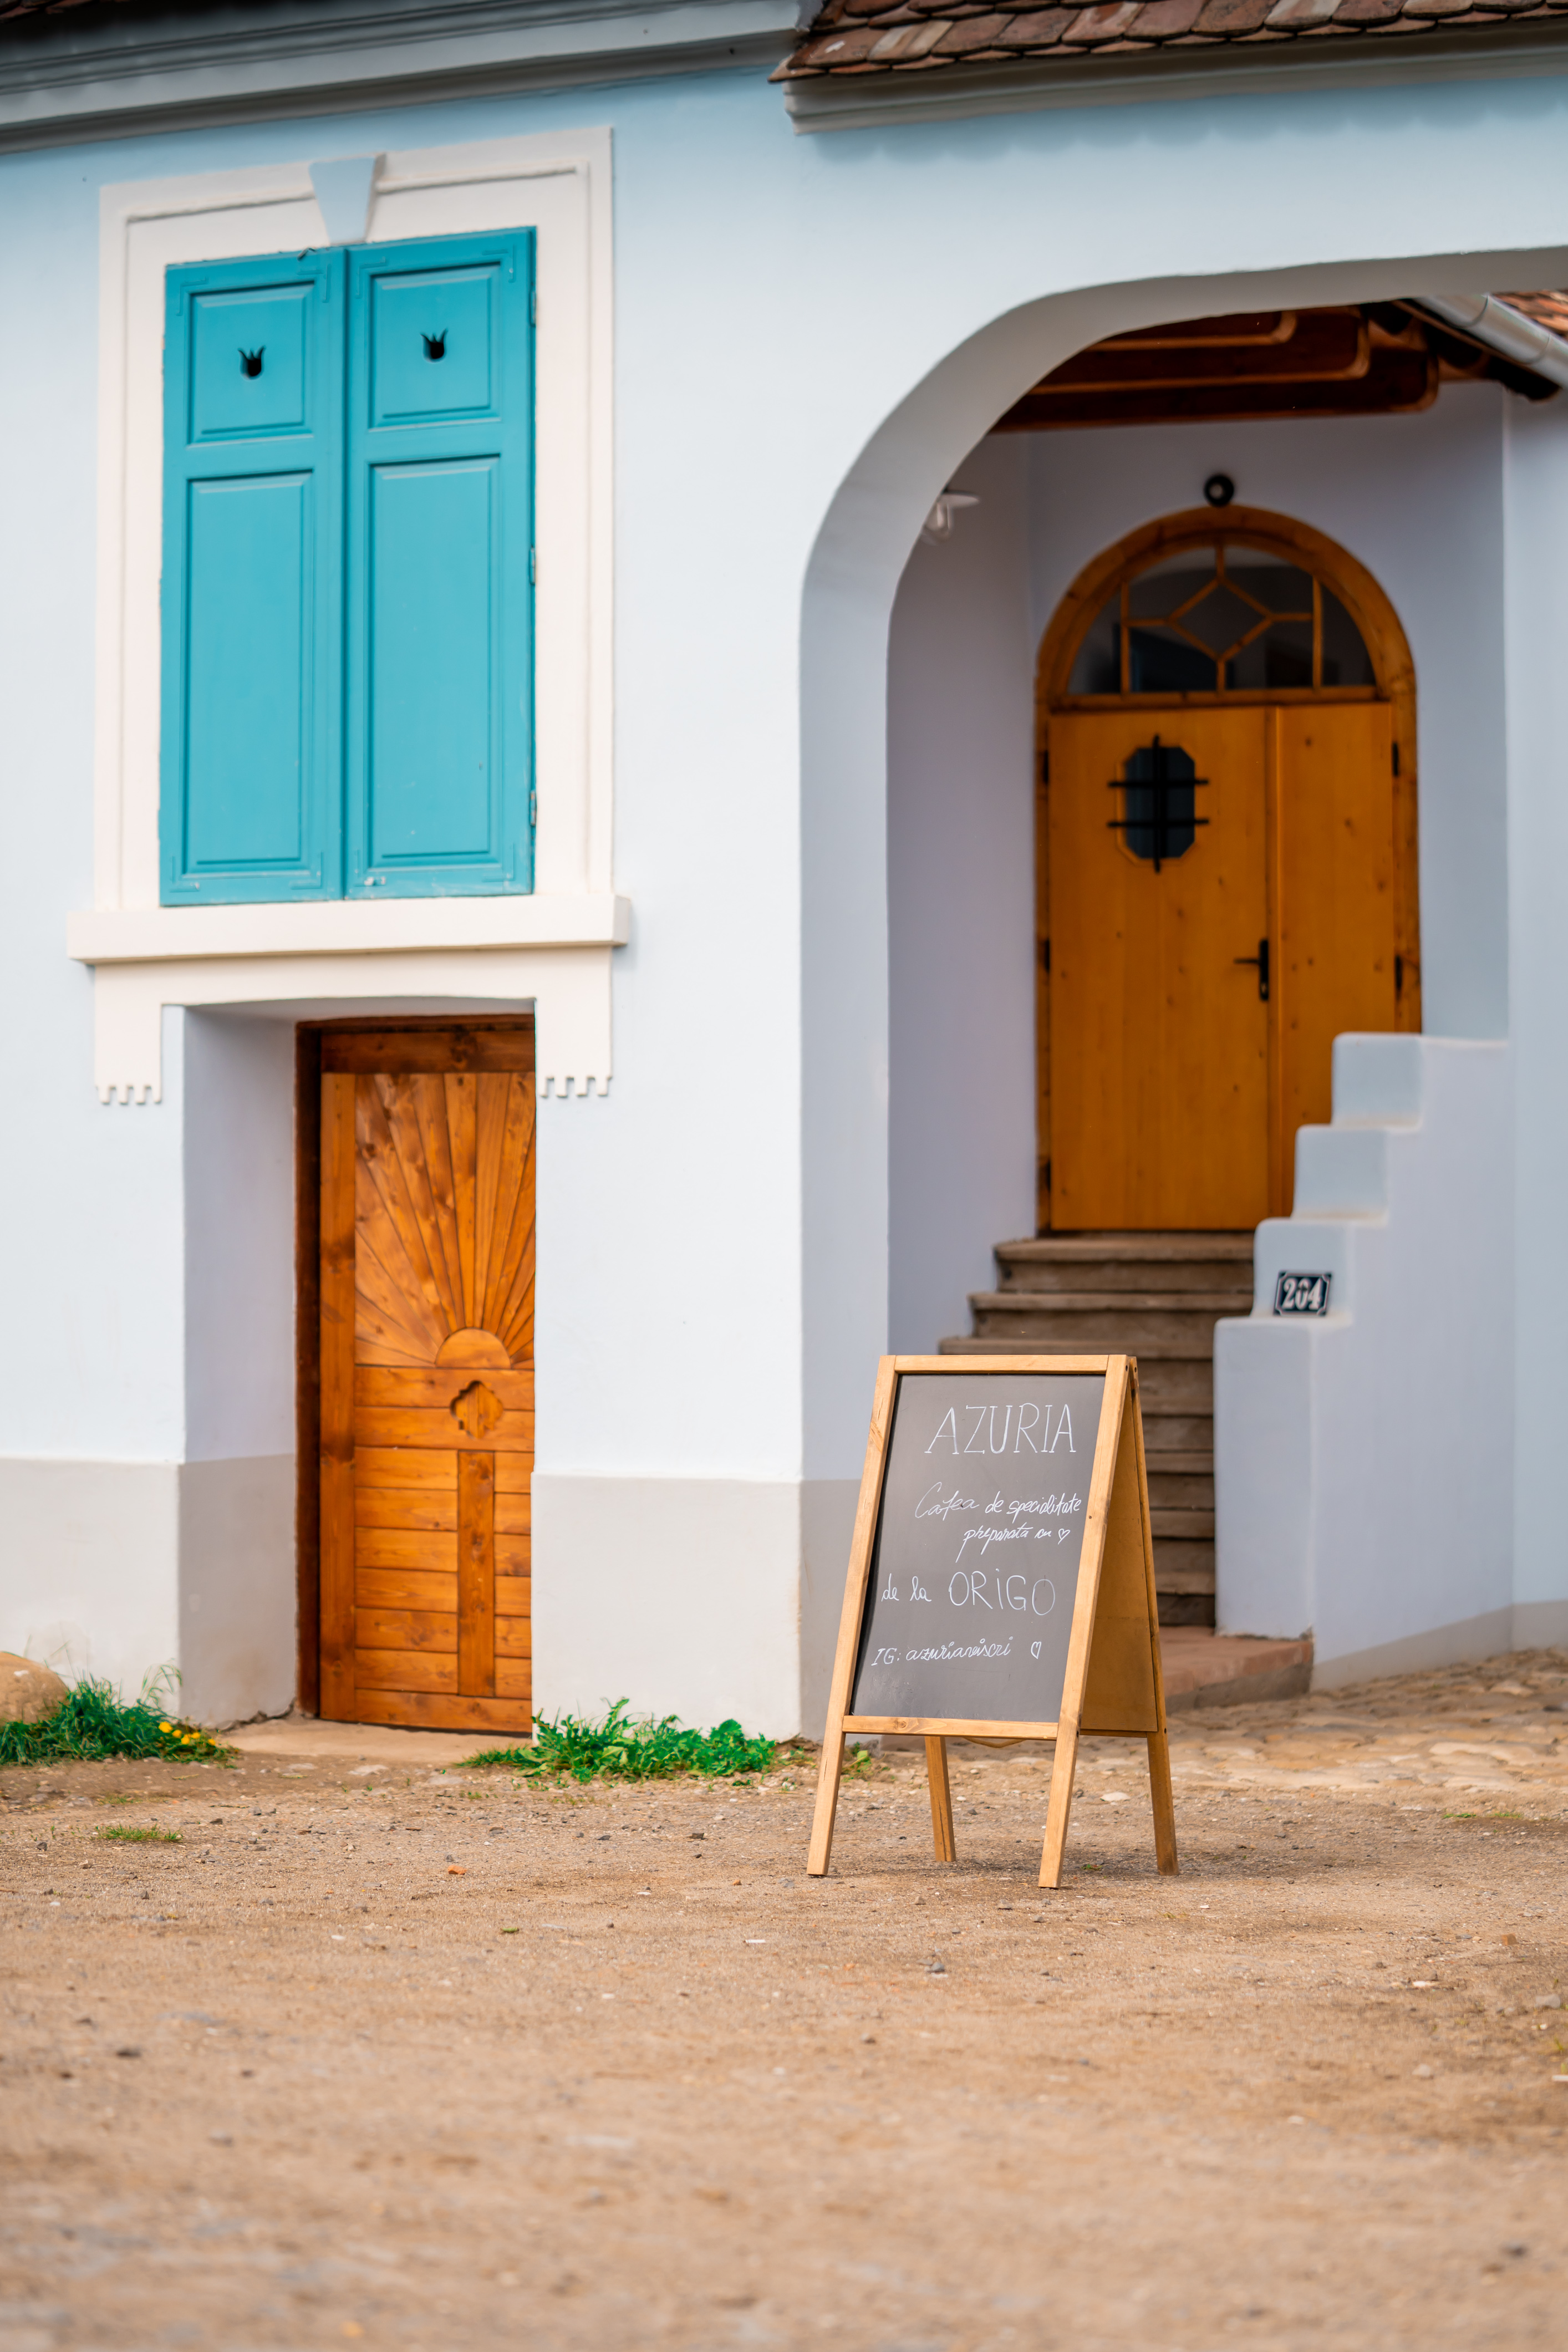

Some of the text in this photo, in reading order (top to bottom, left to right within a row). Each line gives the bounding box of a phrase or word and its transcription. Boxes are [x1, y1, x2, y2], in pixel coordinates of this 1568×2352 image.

[1281, 1277, 1321, 1310] 204
[924, 1403, 1076, 1455] AZURIA
[915, 1482, 980, 1521] Cafea
[985, 1490, 1004, 1513] de
[881, 1573, 899, 1602] de
[910, 1576, 931, 1602] la
[870, 1647, 902, 1666] IG:
